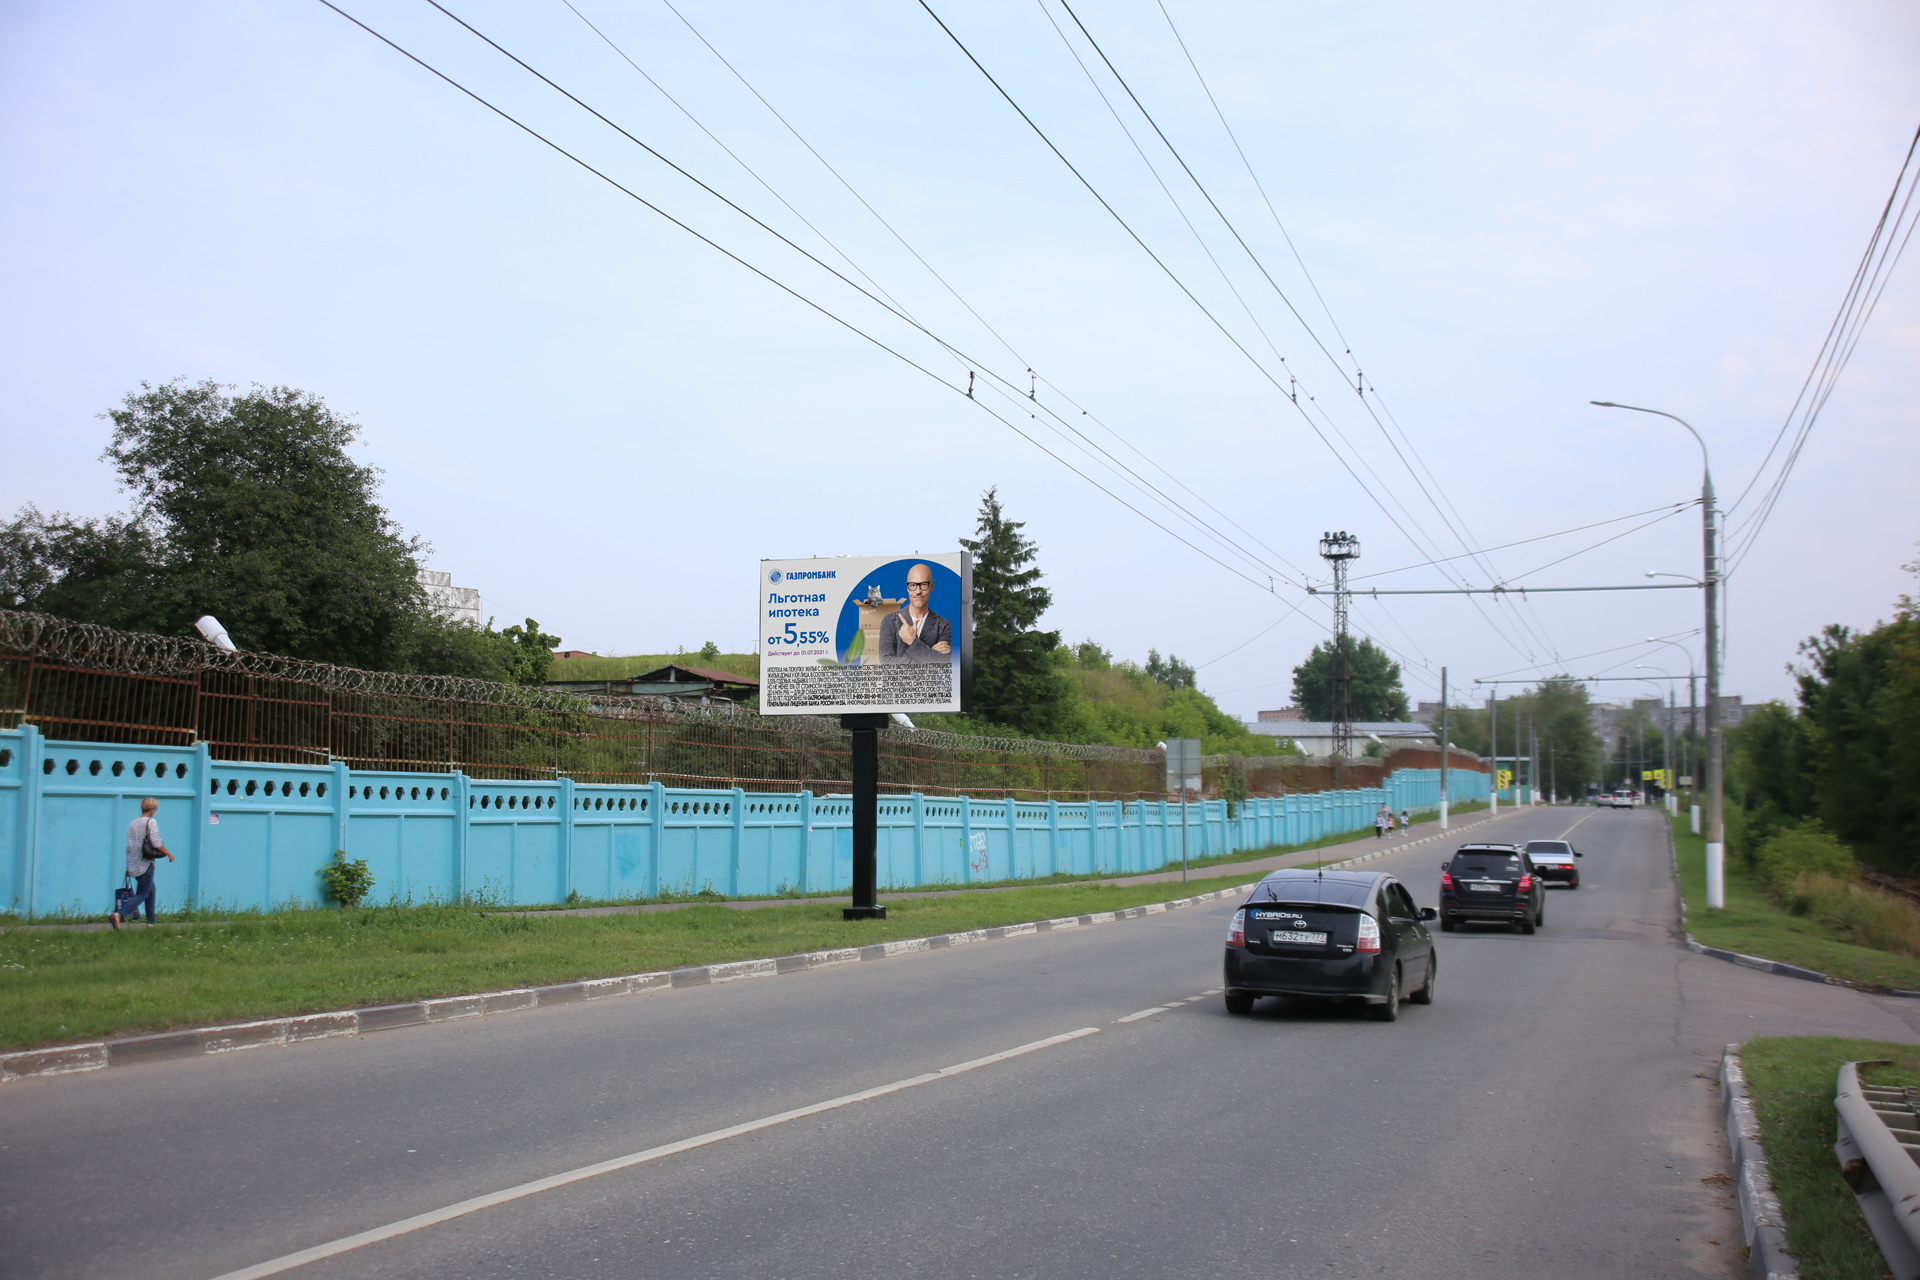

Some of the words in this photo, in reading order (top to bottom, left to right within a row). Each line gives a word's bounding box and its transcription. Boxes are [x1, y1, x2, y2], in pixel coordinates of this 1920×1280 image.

[786, 571, 836, 580] ГАЗПРОМБАНК
[768, 593, 826, 604] Льготная
[768, 608, 820, 618] ипотека
[768, 636, 782, 644] от
[783, 623, 829, 647] 5,55%
